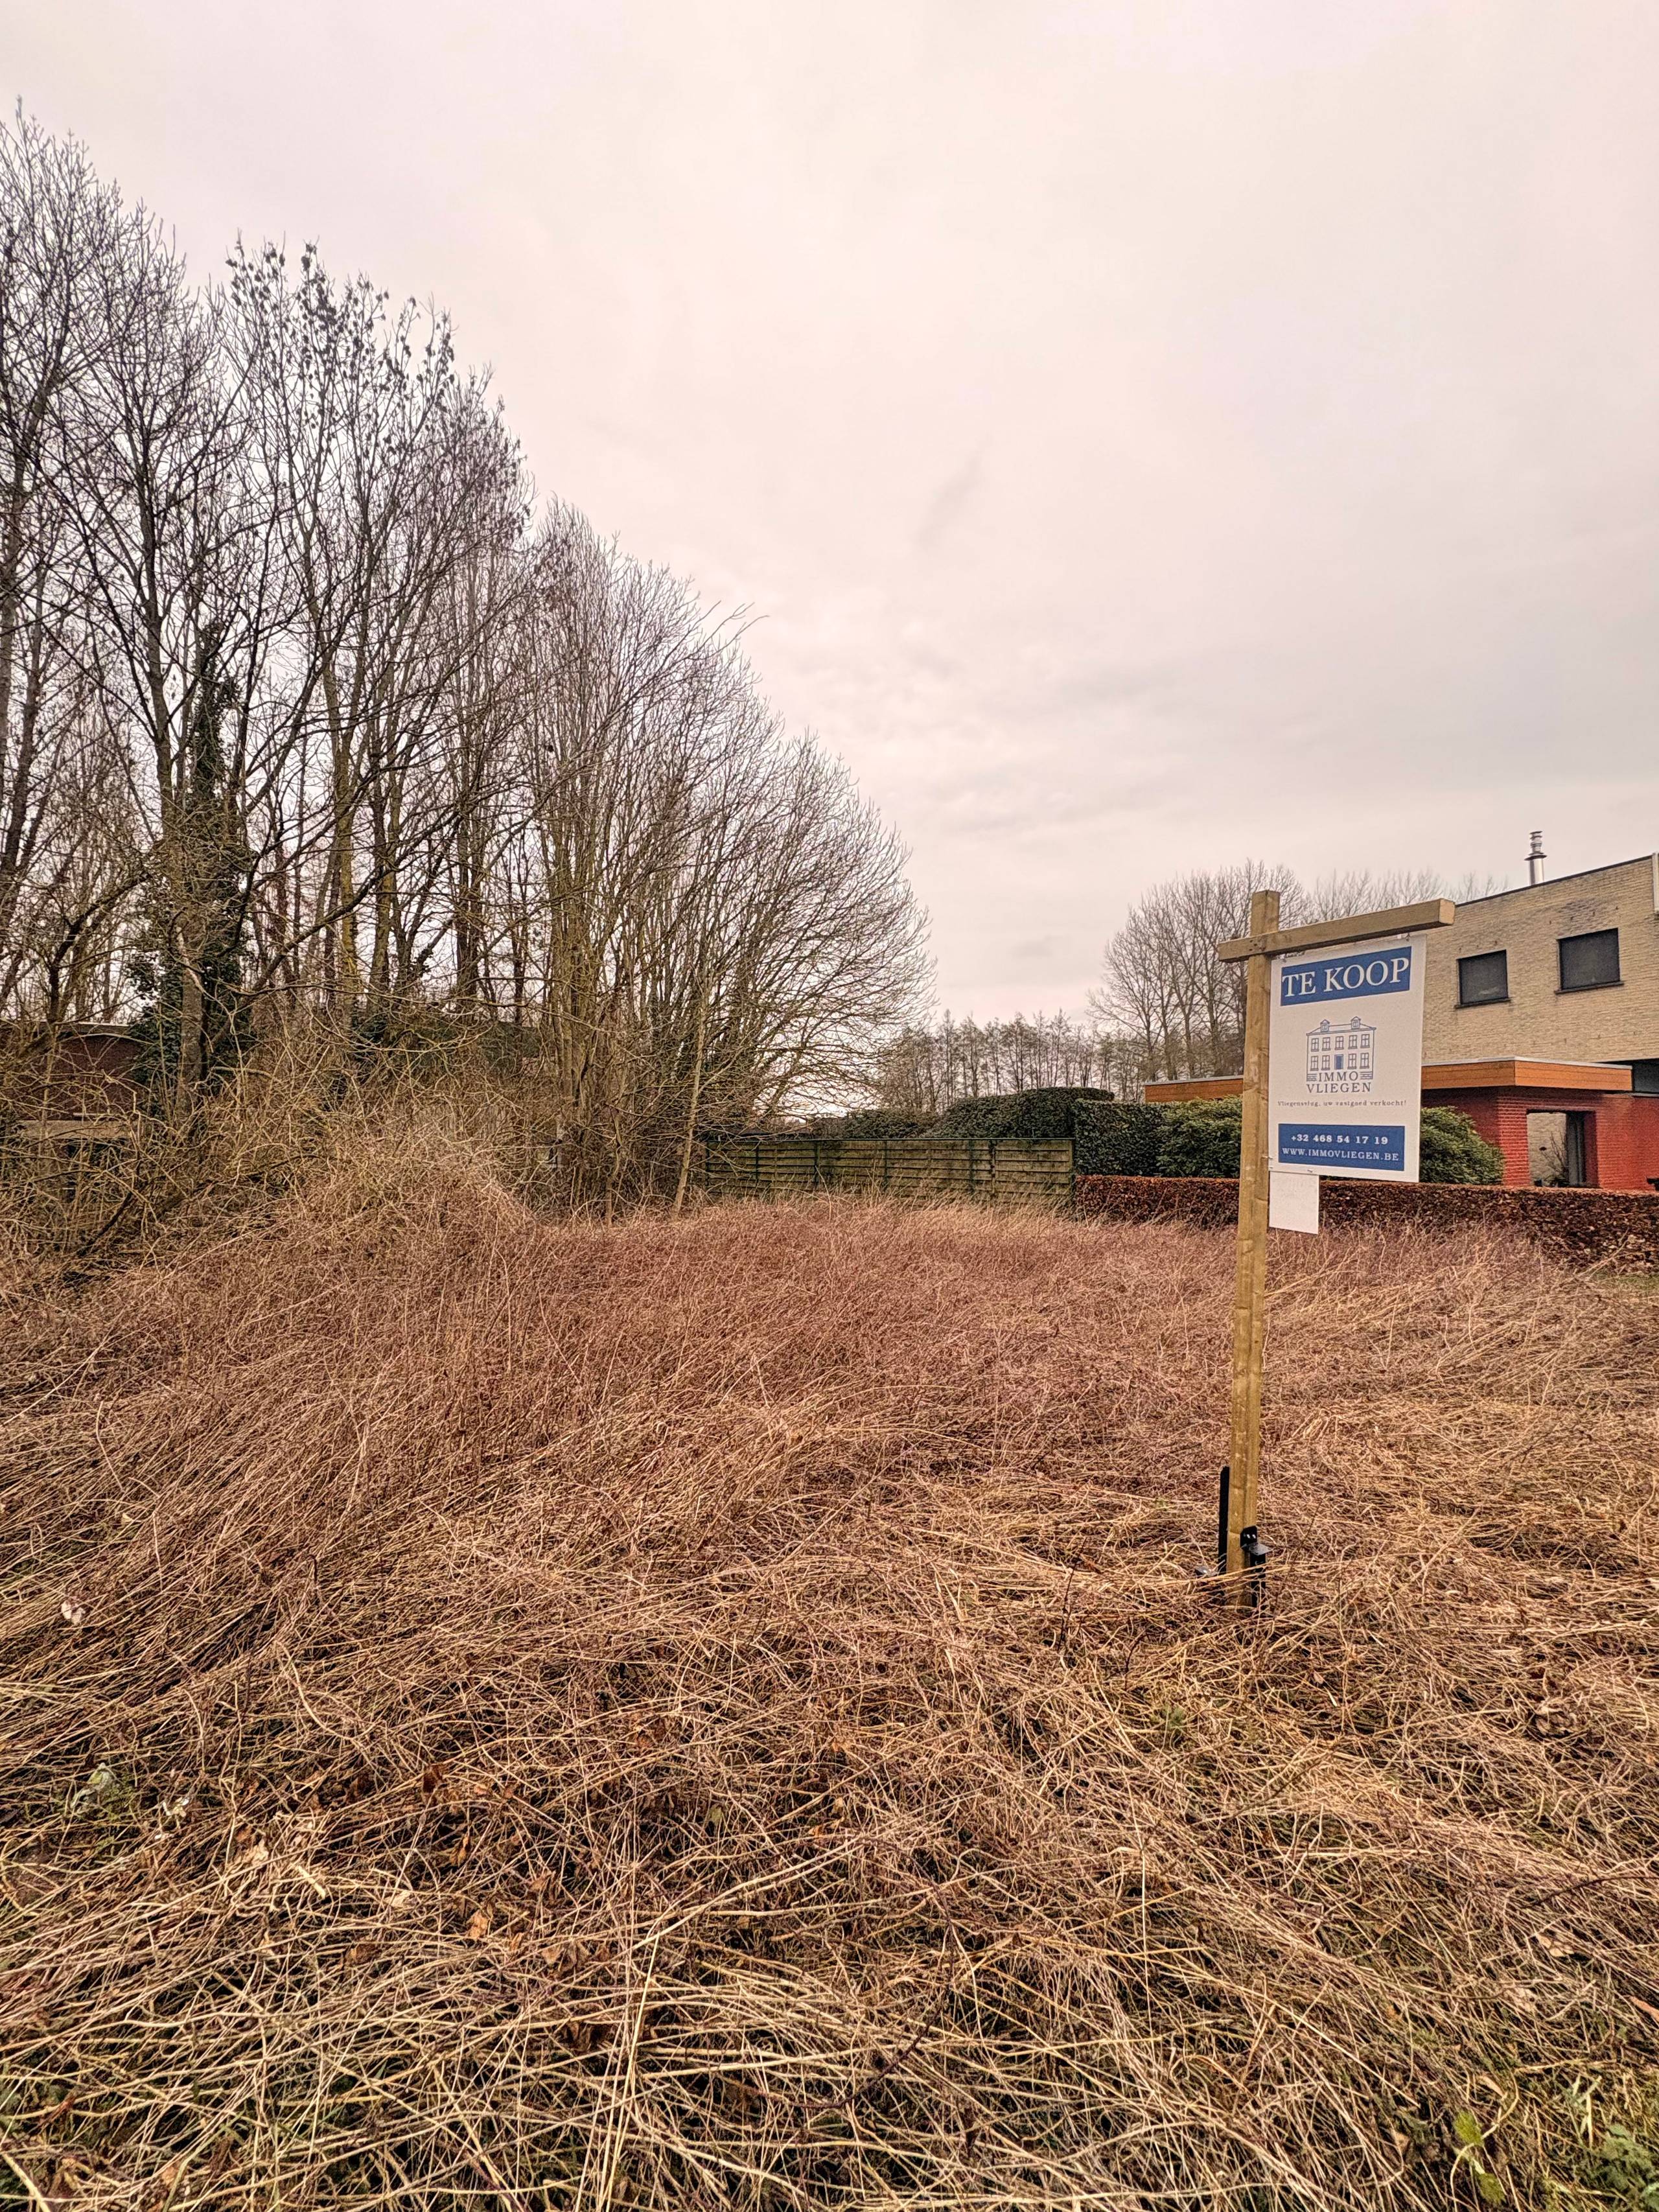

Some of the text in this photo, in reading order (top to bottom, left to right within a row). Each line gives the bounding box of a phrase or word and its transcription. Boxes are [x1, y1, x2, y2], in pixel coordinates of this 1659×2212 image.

[1282, 957, 1410, 997] TE KOOP
[1318, 1071, 1358, 1082] IMMO
[1306, 1082, 1372, 1093] VLIEGEN
[1375, 1137, 1389, 1145] 19
[1282, 1147, 1399, 1161] WWW.IMMOVLIEGEN.BE
